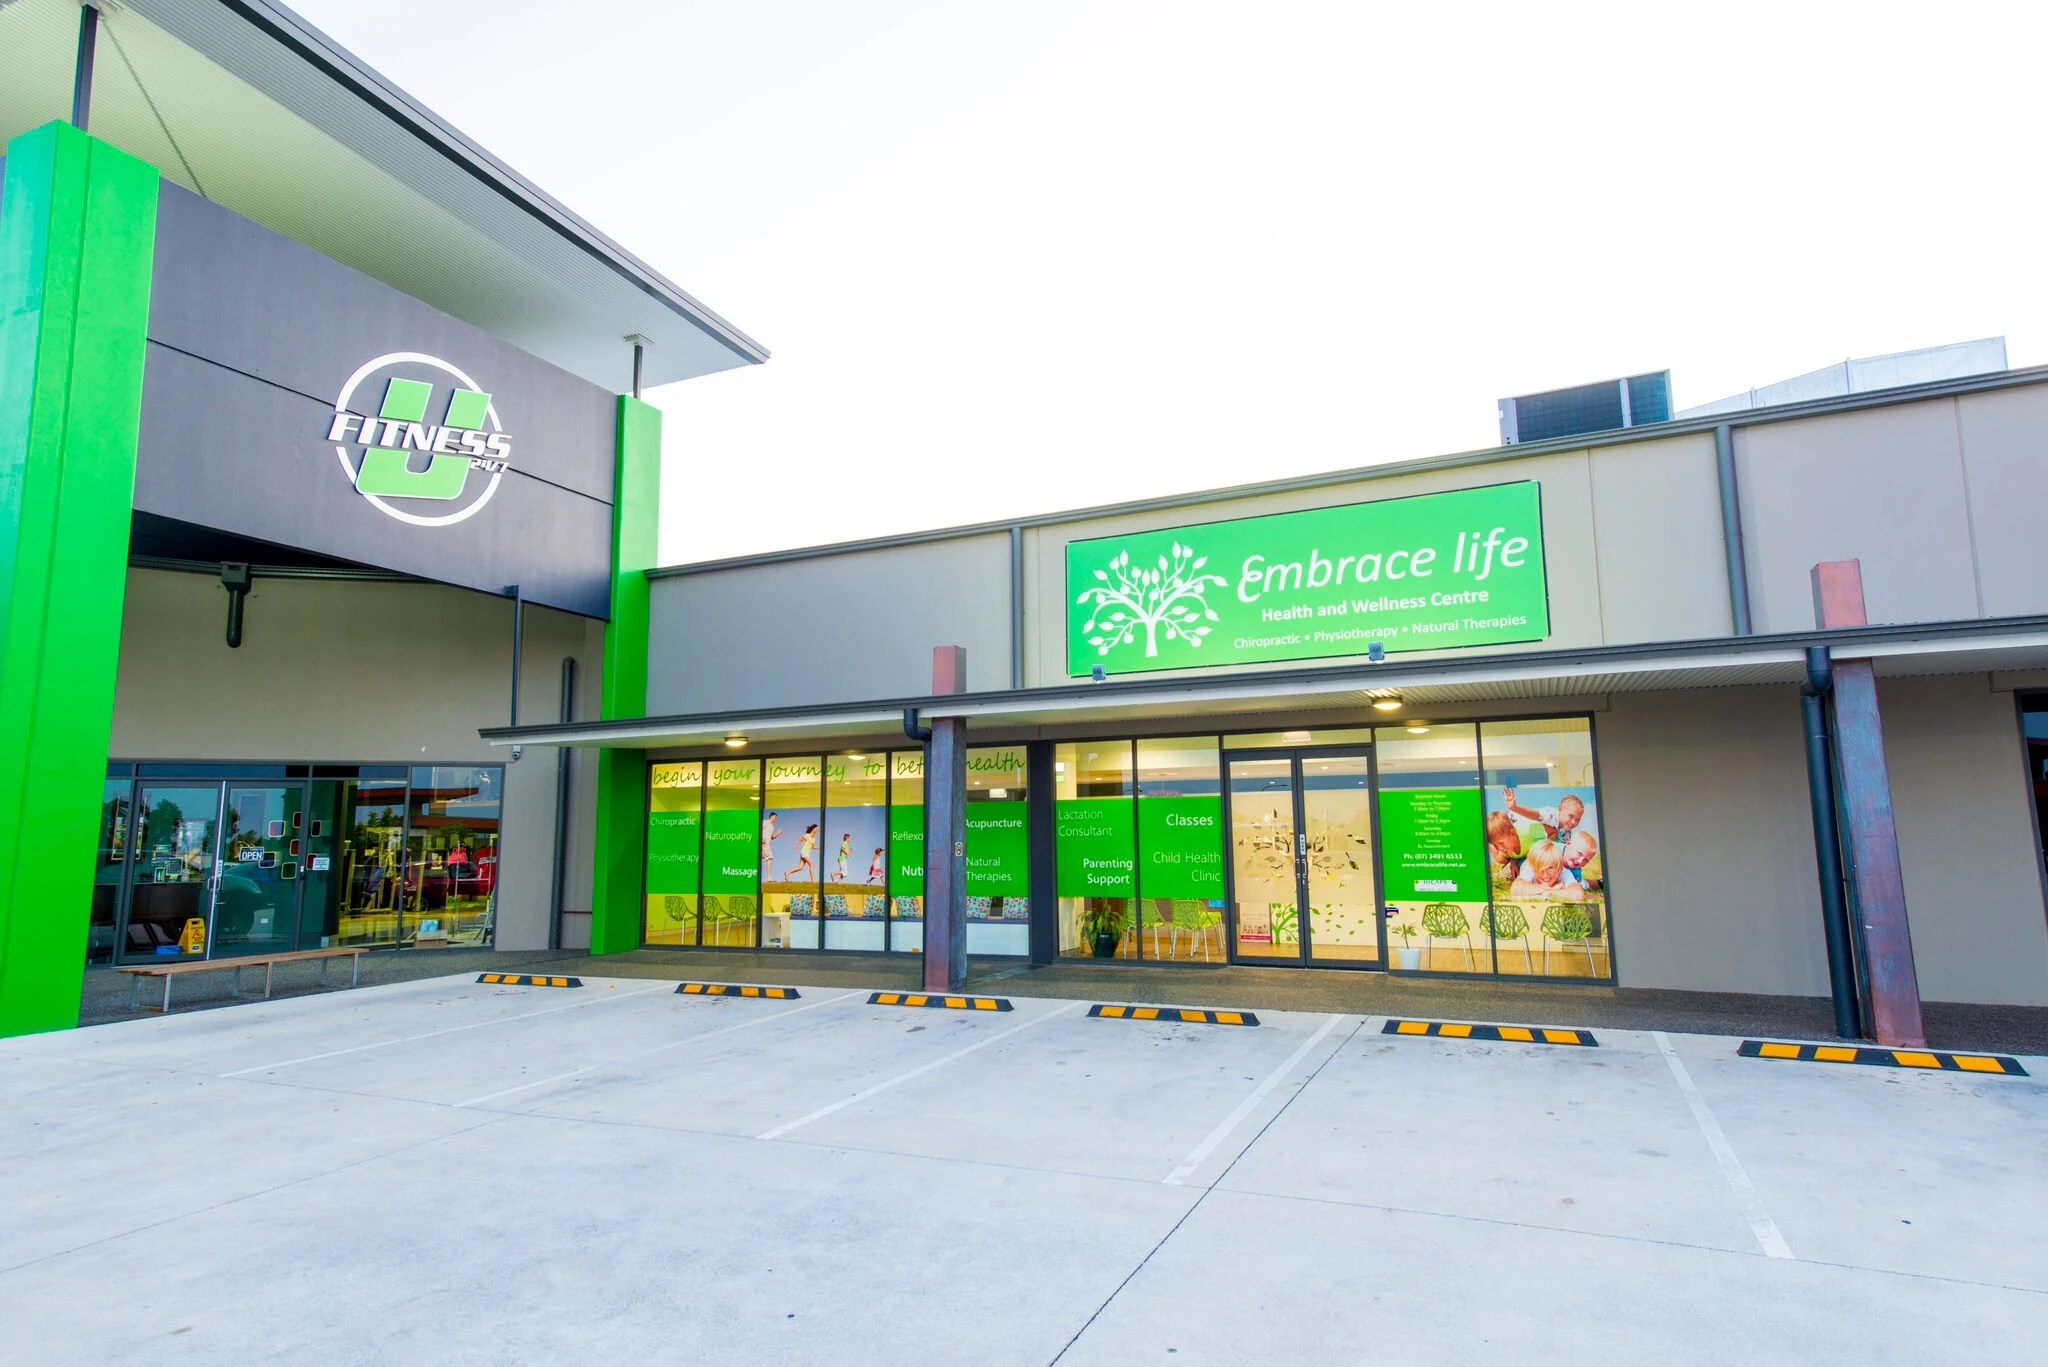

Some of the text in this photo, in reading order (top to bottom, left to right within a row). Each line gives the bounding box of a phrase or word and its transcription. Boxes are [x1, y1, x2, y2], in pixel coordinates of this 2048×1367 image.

[327, 413, 512, 459] FITNESS
[470, 457, 509, 473] 24/7
[1237, 527, 1529, 603] Embrace life
[1261, 589, 1489, 623] Health and Wellness Centre
[1233, 614, 1527, 650] Chiropractic Physiotherapy Natural Therapies
[653, 766, 702, 789] begin
[713, 767, 756, 786] your
[765, 760, 845, 783] journey
[864, 759, 885, 777] to
[896, 755, 925, 776] bet
[1058, 809, 1104, 820] Lactation
[1166, 813, 1213, 826] Classes
[650, 816, 1023, 842] Chiropractic Naturopathy Reflexo Acupuncture
[1058, 825, 1112, 837] Consultant
[242, 851, 263, 860] OPEN
[649, 853, 700, 865] Physiotherapy
[966, 857, 1001, 867] Natural
[1153, 851, 1221, 864] Child Health
[1083, 857, 1133, 871] Parenting
[722, 866, 758, 879] Massage
[902, 865, 924, 877] Nut
[966, 871, 1012, 883] Therapies
[1191, 870, 1221, 882] Clinic
[1087, 873, 1130, 886] Support
